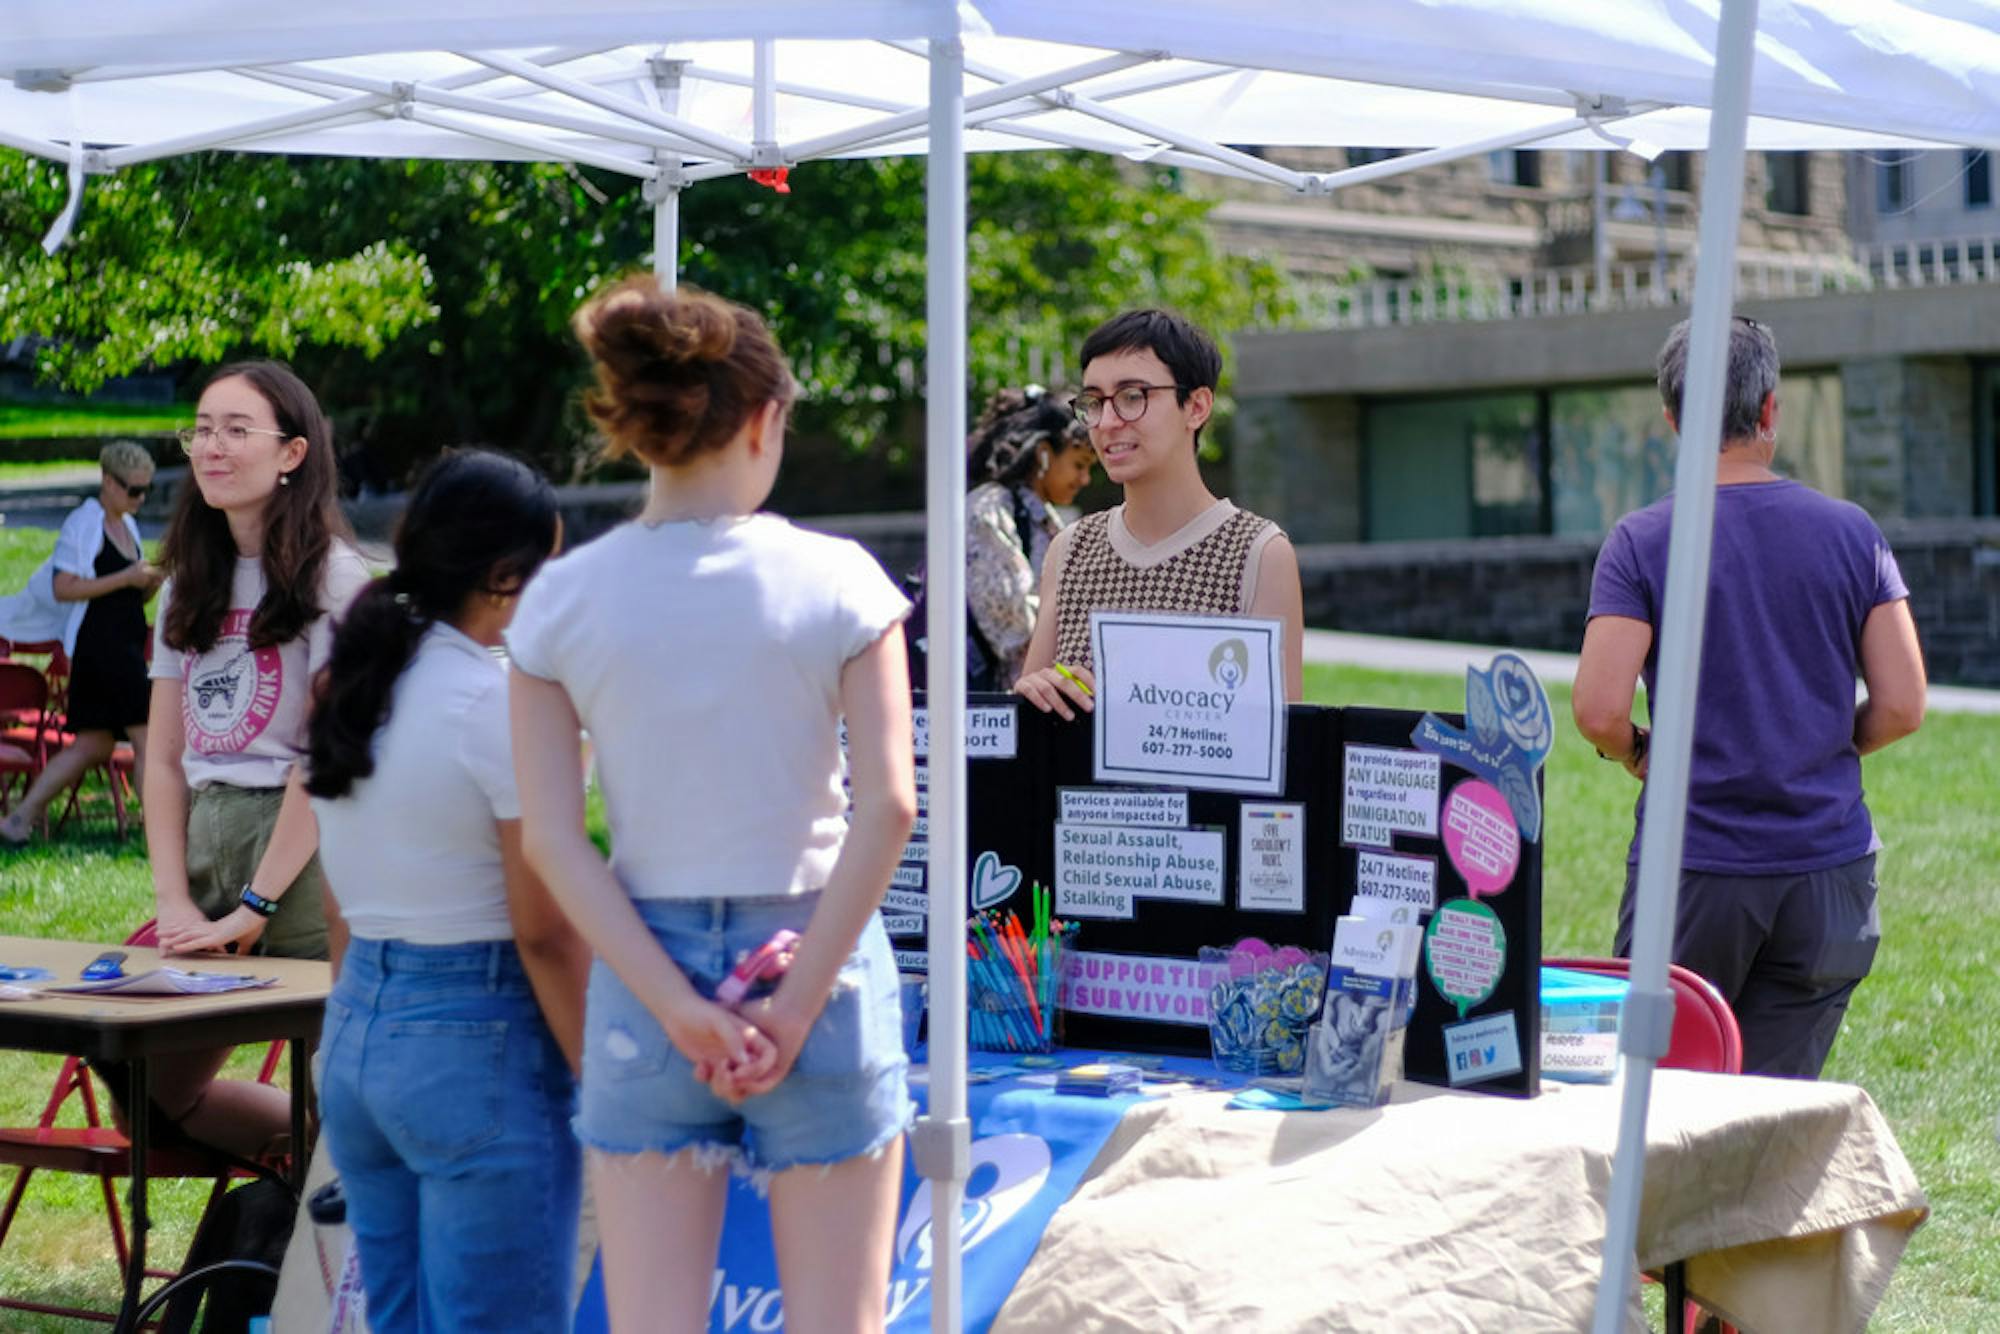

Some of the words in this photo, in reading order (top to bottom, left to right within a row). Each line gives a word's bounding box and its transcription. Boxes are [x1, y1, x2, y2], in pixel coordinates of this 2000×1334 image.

[252, 669, 278, 719] RINK
[1128, 682, 1235, 714] Advocacy
[971, 713, 1011, 729] Find
[1165, 709, 1222, 721] CENTER
[1148, 725, 1178, 740] 24/7
[1180, 726, 1228, 743] Hotline:
[1141, 741, 1234, 760] 607-277-5000
[1347, 751, 1362, 764] We
[1363, 752, 1393, 767] provide
[1394, 757, 1427, 770] support
[1429, 757, 1437, 768] in
[1347, 767, 1373, 783] ANY
[1374, 769, 1437, 791] LANGUAGE
[1063, 793, 1111, 806] Services
[1112, 795, 1165, 809] available
[1167, 797, 1185, 809] for
[1347, 785, 1355, 797] &
[1356, 787, 1397, 801] regardless
[1398, 789, 1407, 802] of
[1067, 808, 1108, 822] anyone
[1111, 808, 1164, 823] impacted
[1168, 809, 1183, 824] by
[1347, 803, 1427, 827] IMMIGRATION
[1062, 829, 1113, 846] Sexual
[1116, 831, 1184, 850] Assault,
[1346, 823, 1388, 842] STATUS
[1063, 849, 1161, 872] Relationship
[1165, 853, 1220, 874] Abuse,
[1360, 859, 1383, 877] 24/7
[1385, 863, 1432, 884] Hotline:
[1062, 869, 1101, 886] Child
[1104, 871, 1157, 889] Sexual
[1162, 874, 1217, 895] Abuse,
[1360, 880, 1431, 905] 607-277-5000
[1063, 889, 1126, 912] Stalking
